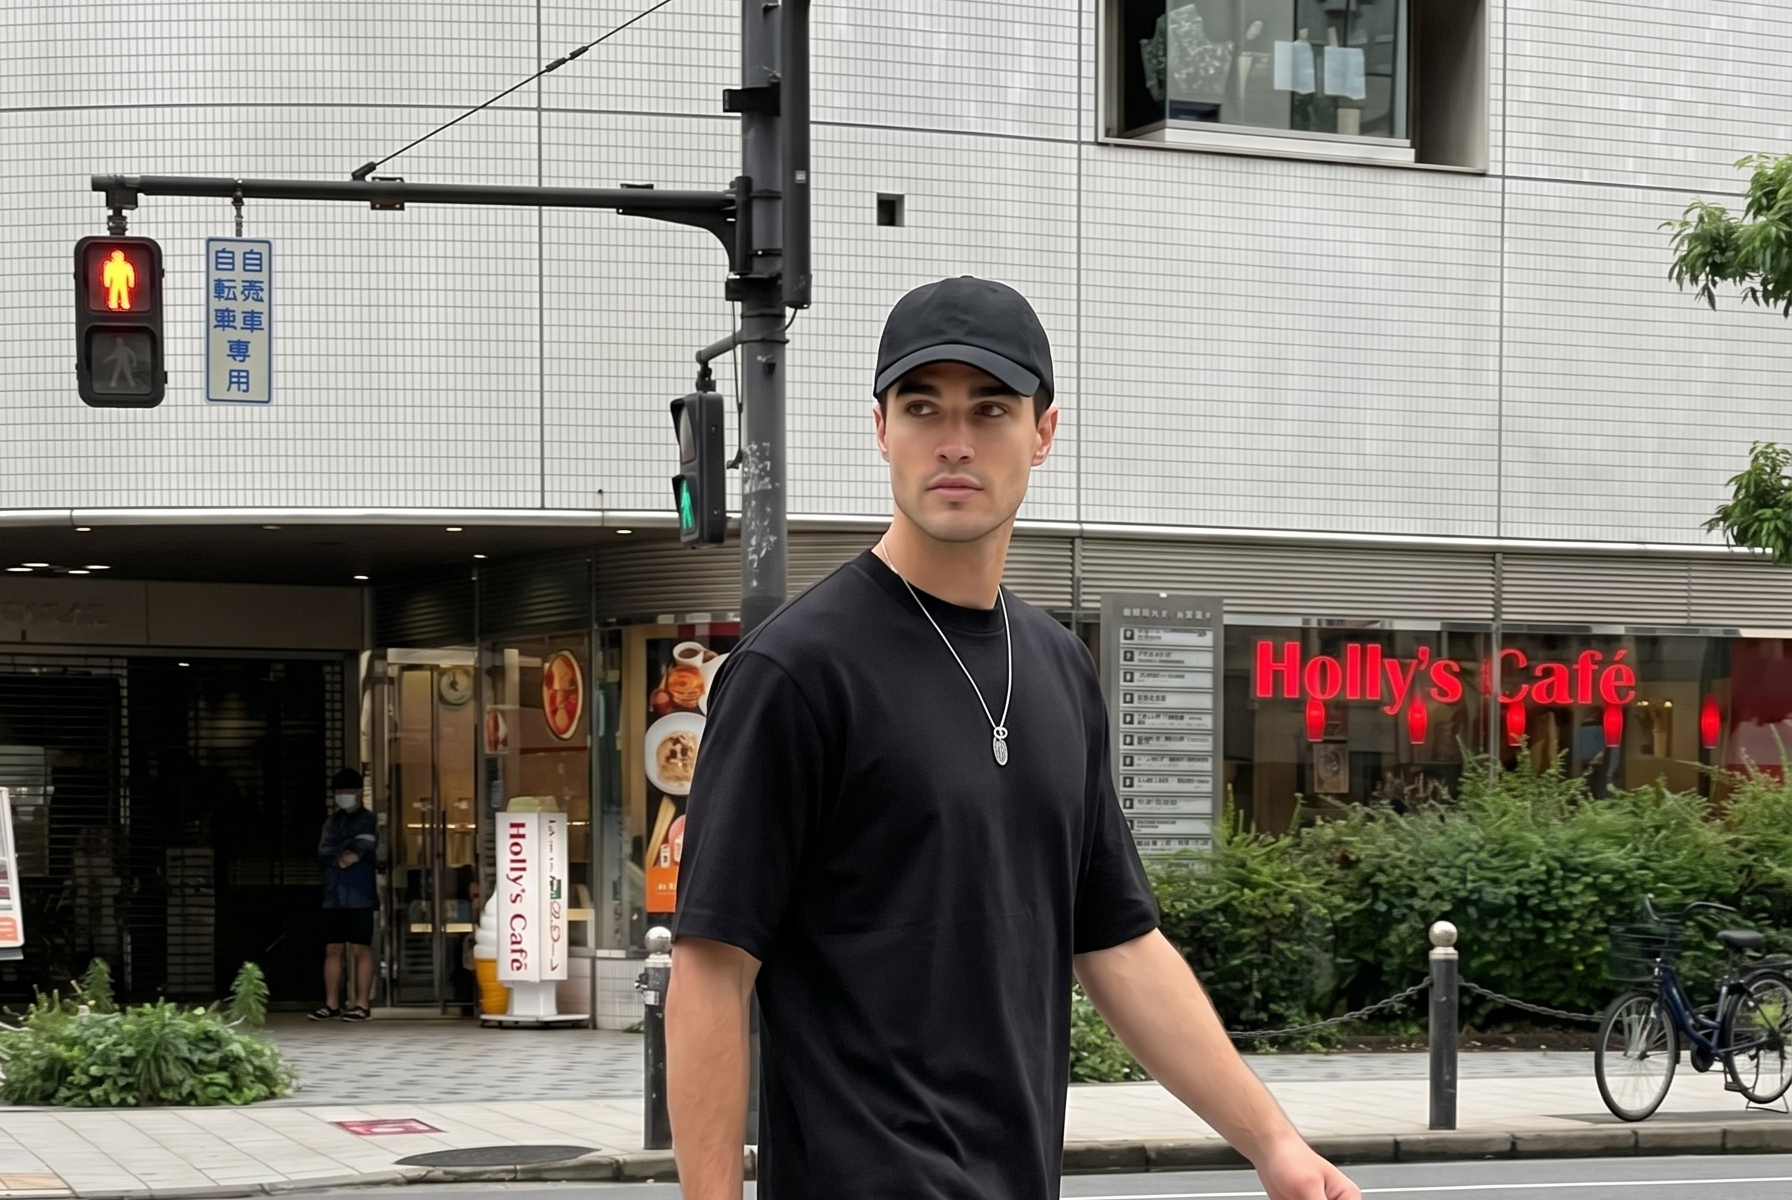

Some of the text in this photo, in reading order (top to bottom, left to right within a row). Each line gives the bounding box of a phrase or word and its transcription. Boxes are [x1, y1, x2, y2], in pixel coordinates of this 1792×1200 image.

[1256, 640, 1636, 715] Holly's Café
[506, 822, 528, 972] Holly's Café
